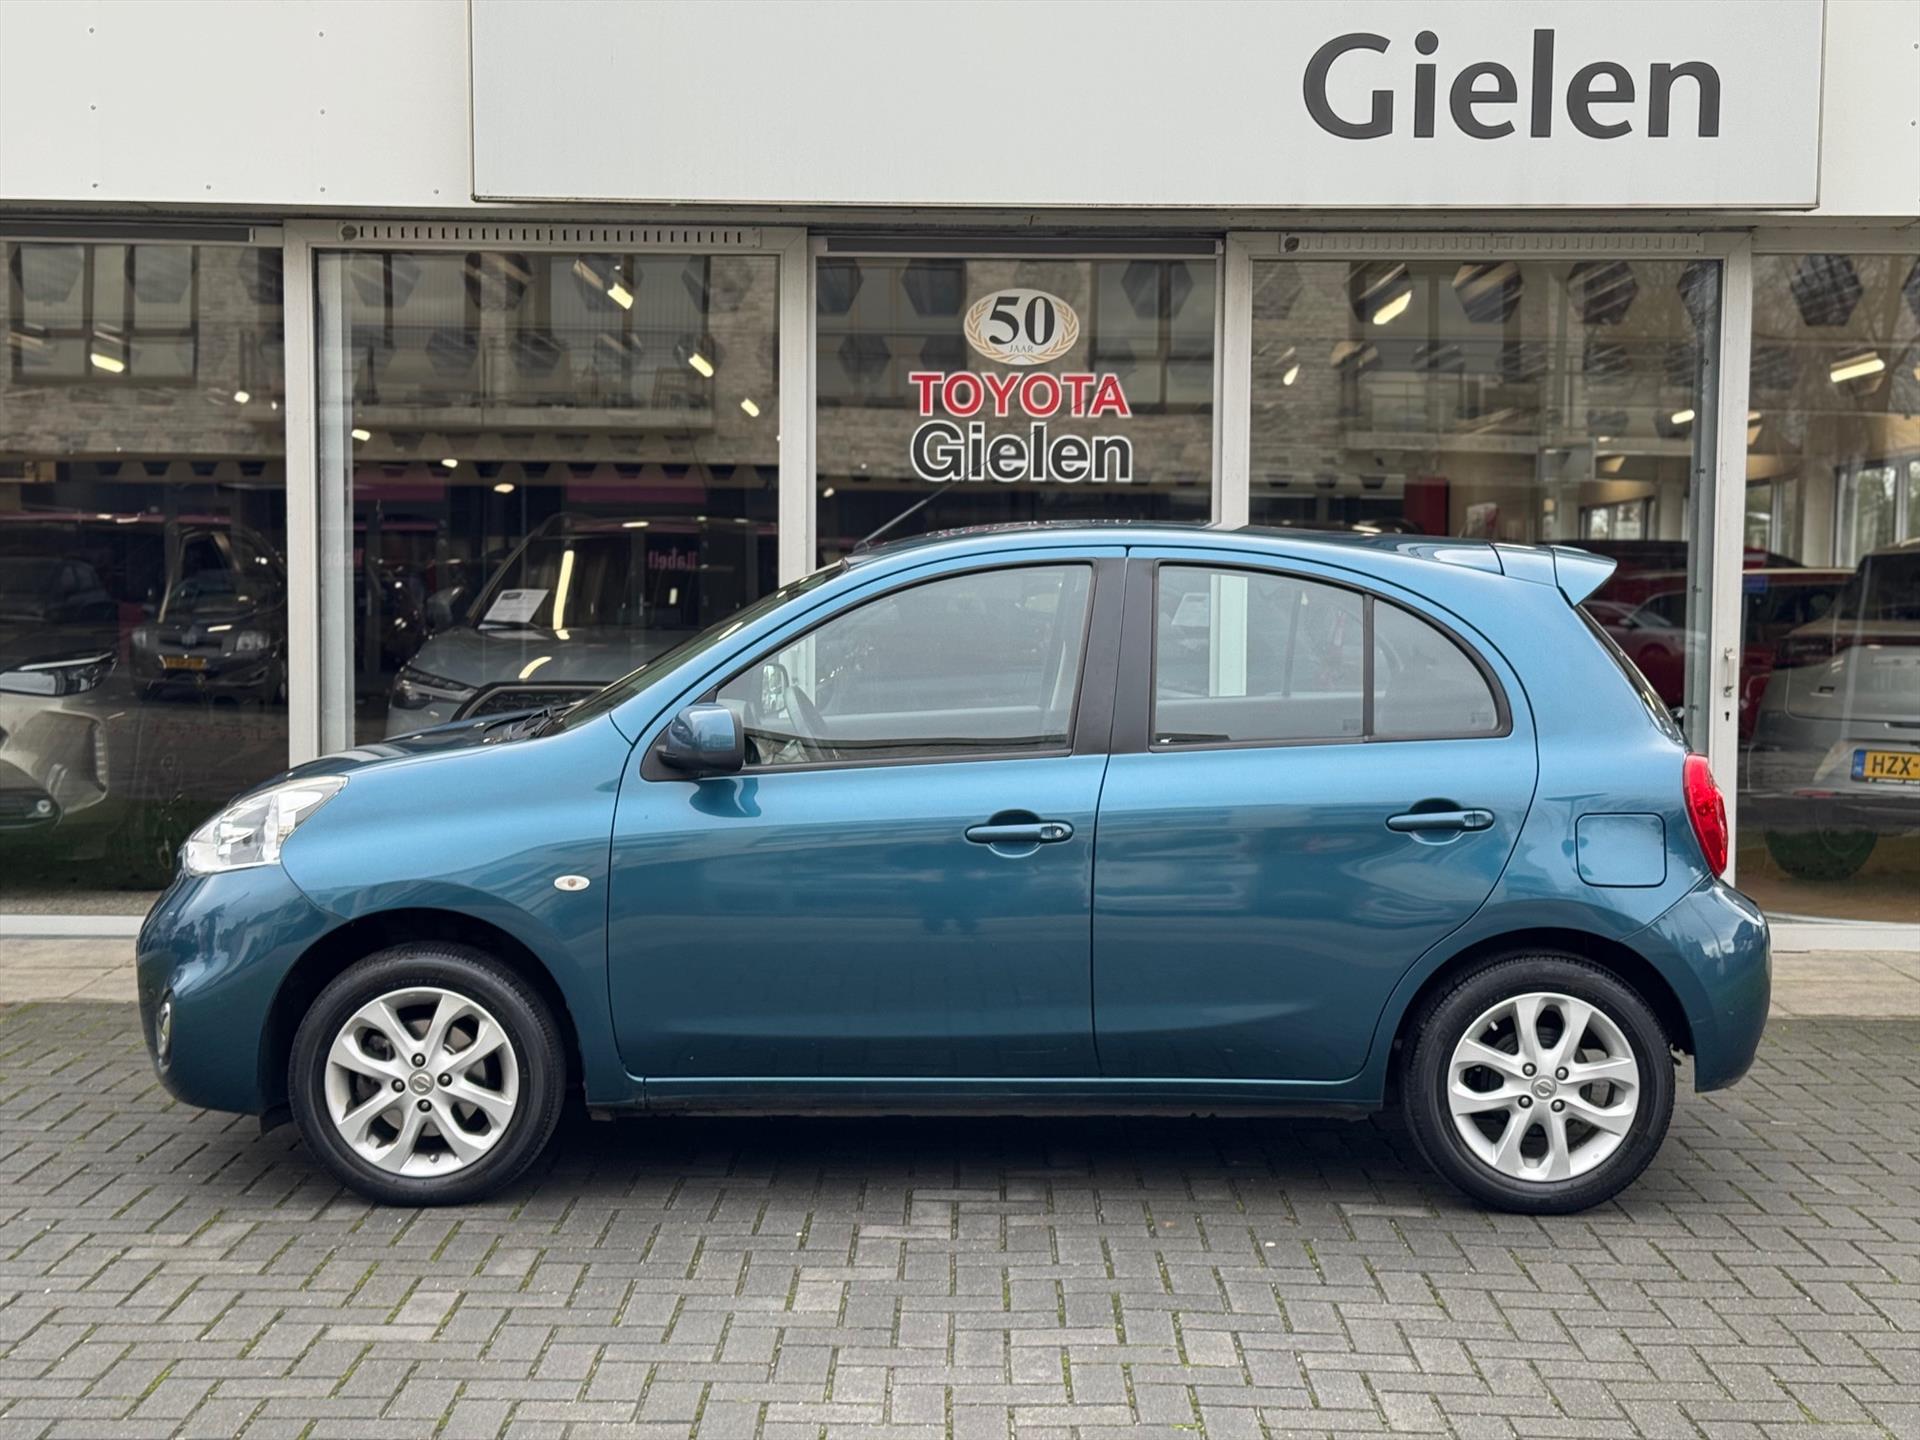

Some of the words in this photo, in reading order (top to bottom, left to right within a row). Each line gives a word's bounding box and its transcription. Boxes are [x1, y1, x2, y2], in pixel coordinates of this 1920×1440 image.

[1303, 29, 1721, 140] Gielen
[988, 295, 1056, 346] 50
[1009, 344, 1034, 353] JAAR
[909, 372, 1132, 417] TOYOTA
[911, 420, 1133, 482] Gielen
